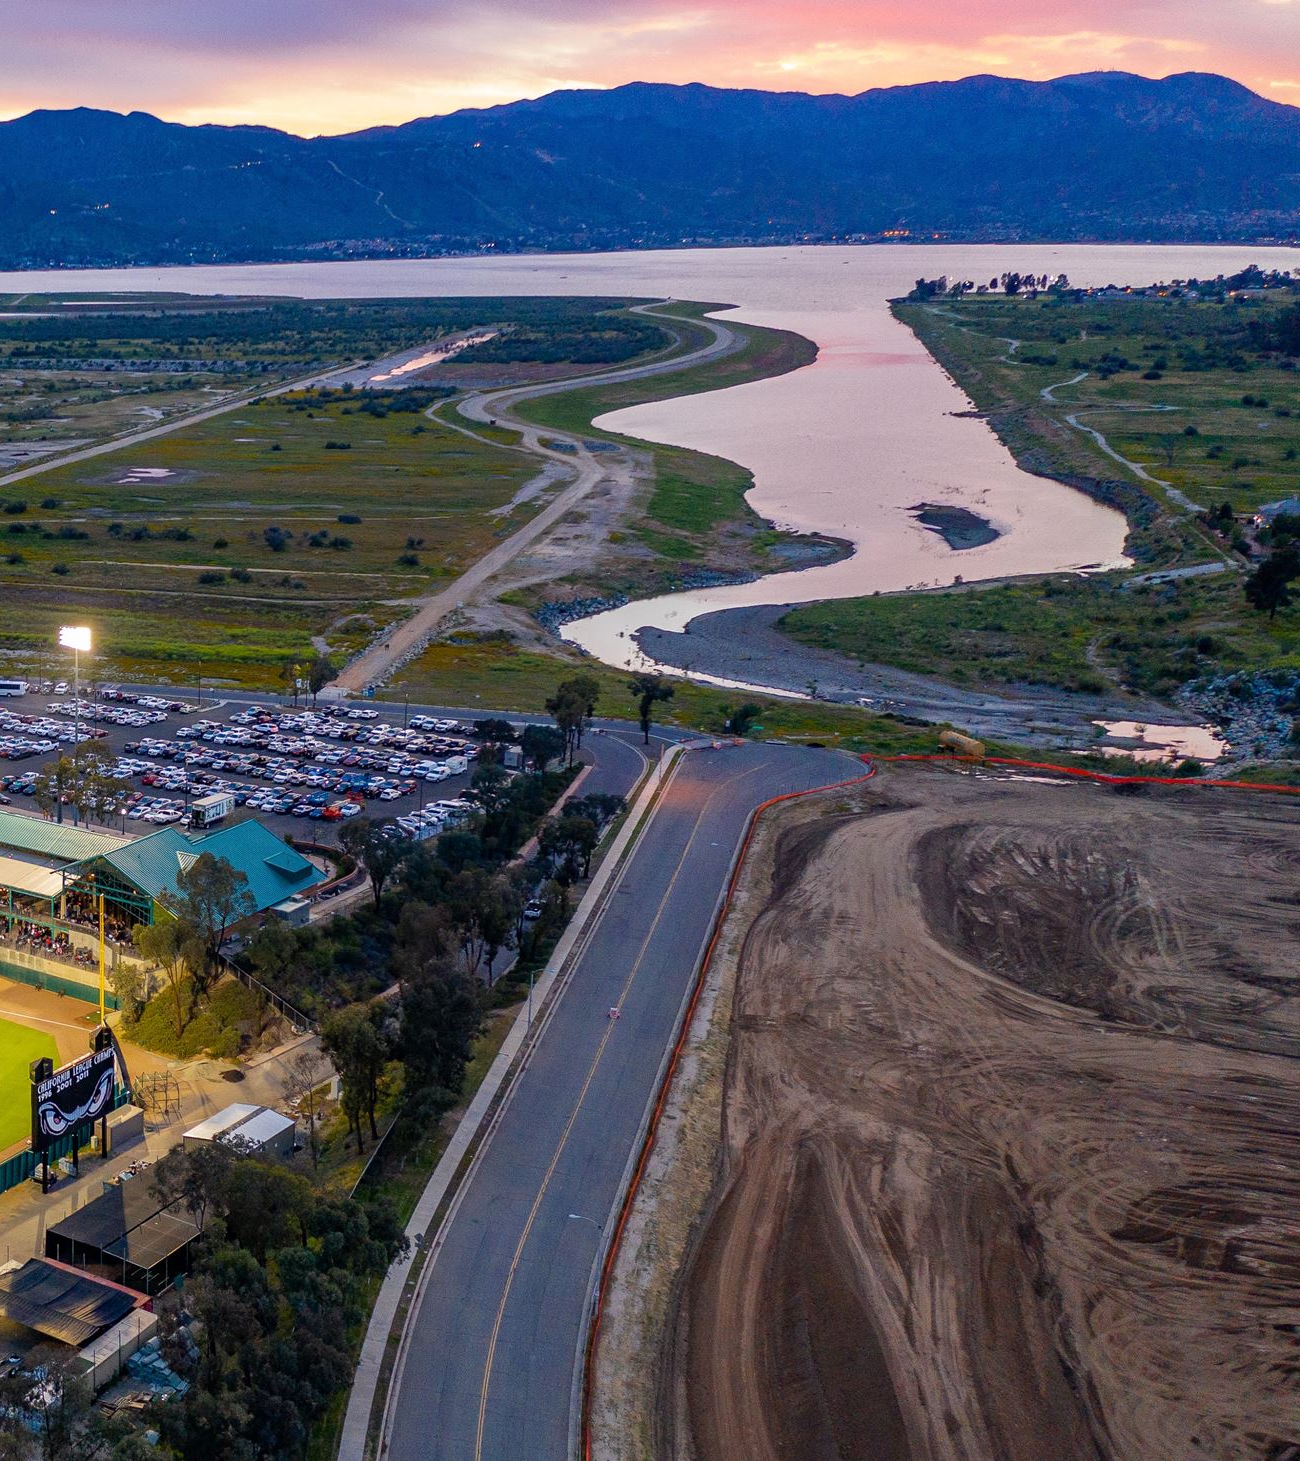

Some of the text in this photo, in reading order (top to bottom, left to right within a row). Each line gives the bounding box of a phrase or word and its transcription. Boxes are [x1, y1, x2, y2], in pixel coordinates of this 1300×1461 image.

[37, 1047, 115, 1094] CALIFORNIA LEAGUE CHAMPS
[38, 1070, 89, 1103] 1996 2001 2011
